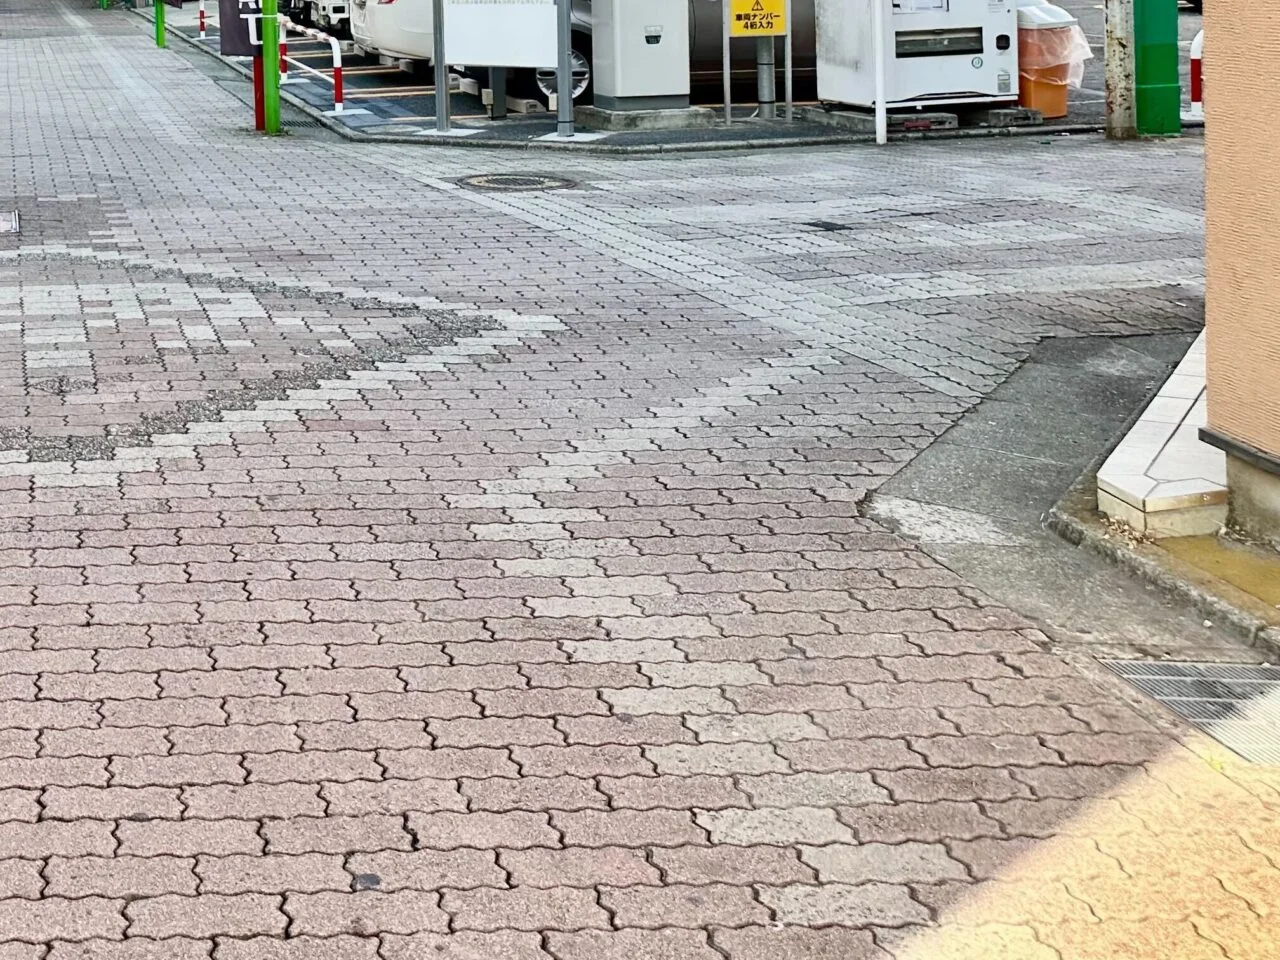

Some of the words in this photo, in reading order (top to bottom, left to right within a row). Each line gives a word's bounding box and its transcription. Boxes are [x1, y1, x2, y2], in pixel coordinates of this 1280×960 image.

[735, 12, 781, 22] 車両ナンバー
[743, 20, 774, 31] 4桁入力
